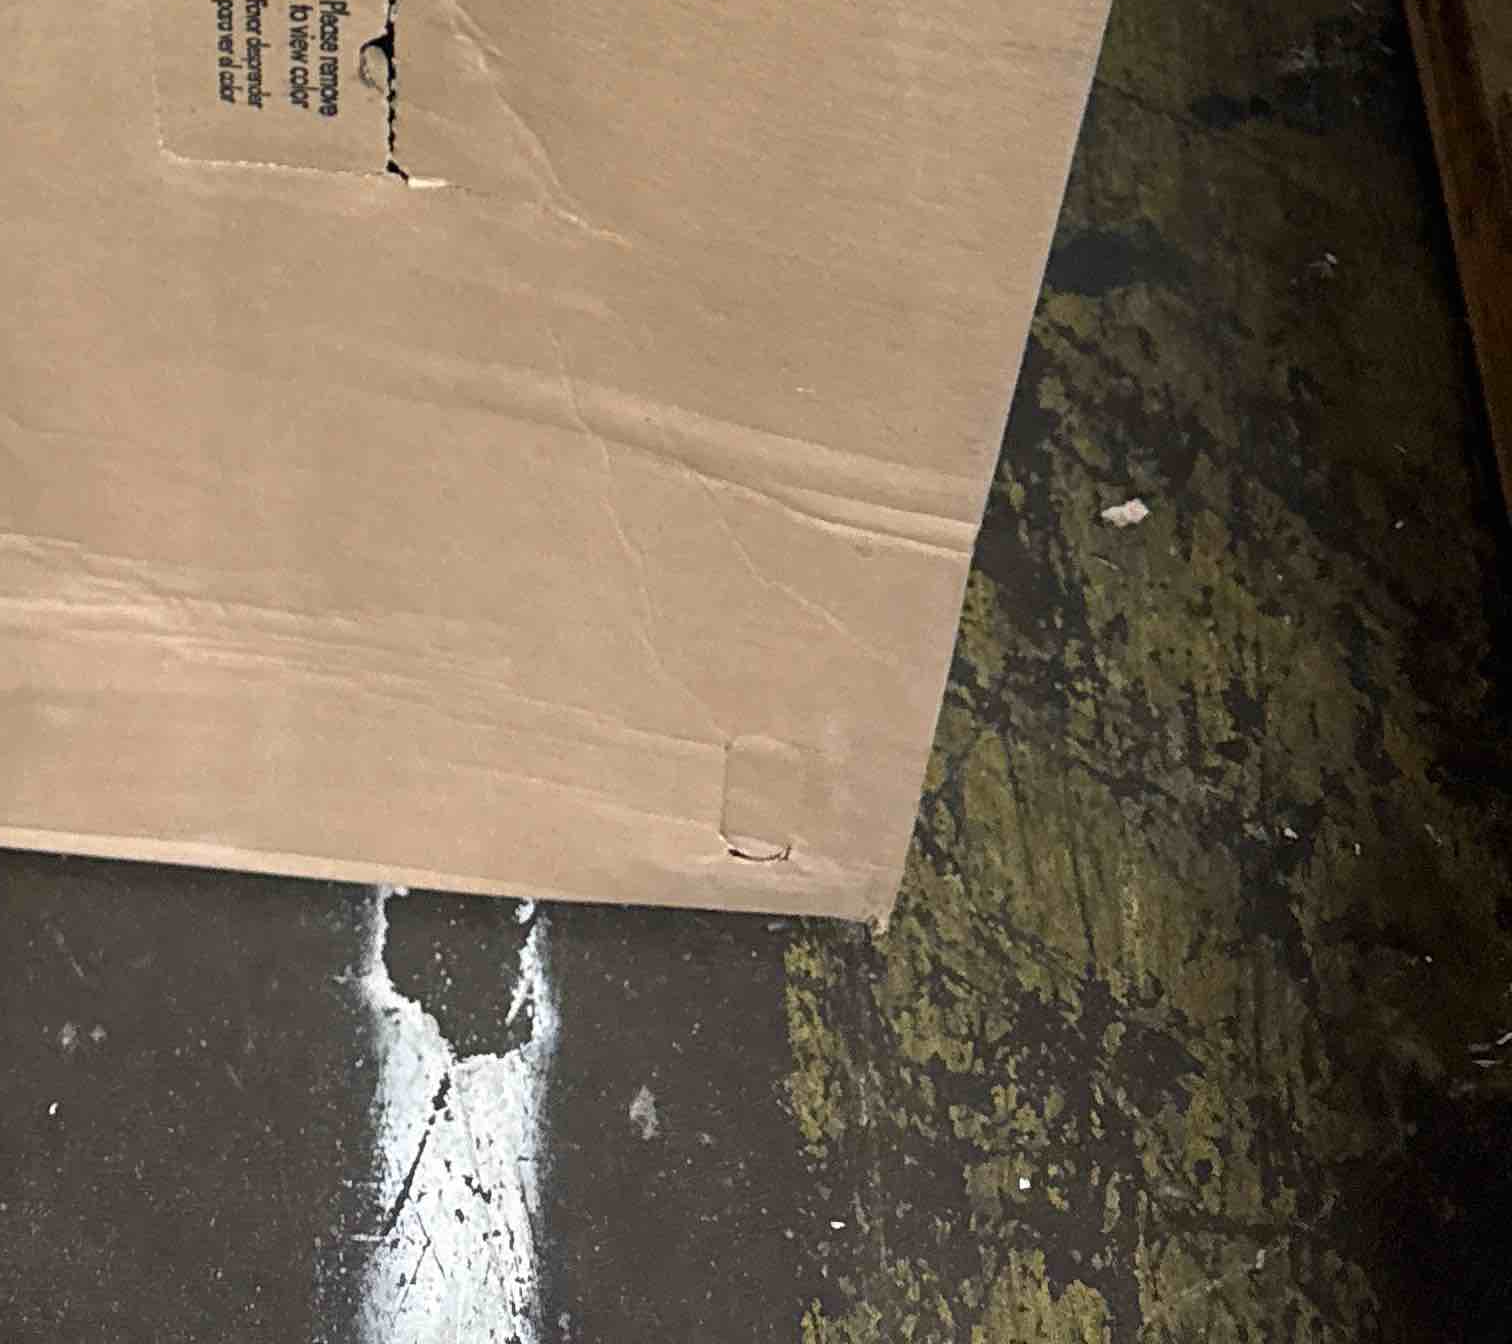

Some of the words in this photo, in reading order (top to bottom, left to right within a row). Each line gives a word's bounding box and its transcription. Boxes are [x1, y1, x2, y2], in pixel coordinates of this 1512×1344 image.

[289, 4, 314, 22] to
[319, 0, 350, 53] Please
[217, 33, 234, 54] ver
[289, 25, 316, 64] view
[219, 71, 244, 103] color
[240, 37, 272, 110] desprender
[290, 66, 320, 109] color
[319, 56, 339, 117] remove
